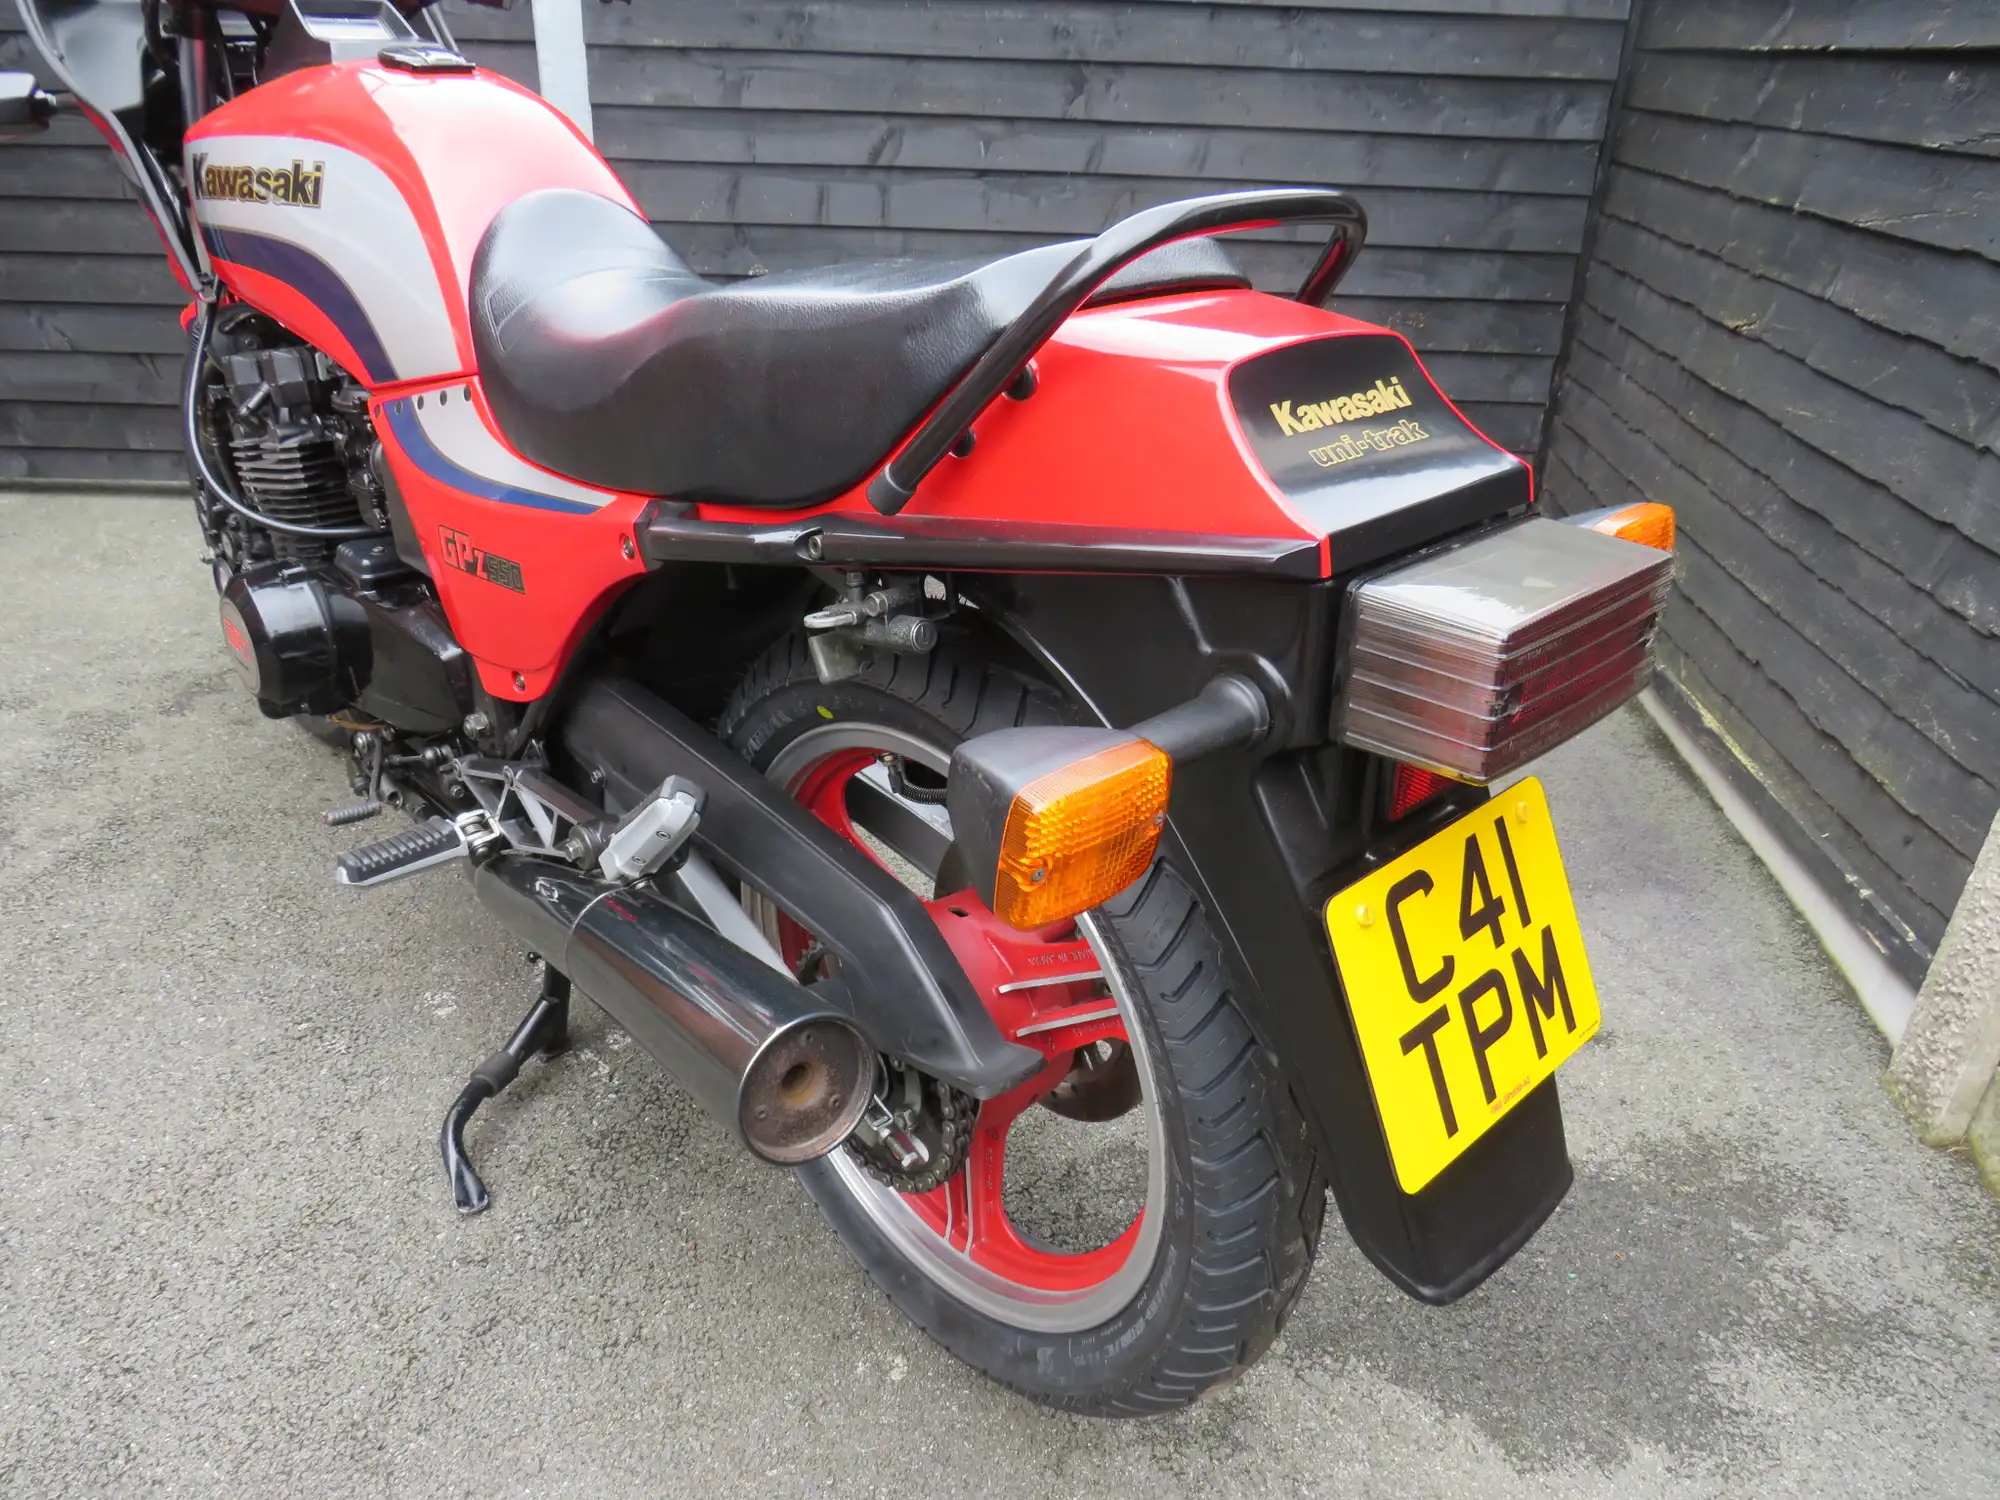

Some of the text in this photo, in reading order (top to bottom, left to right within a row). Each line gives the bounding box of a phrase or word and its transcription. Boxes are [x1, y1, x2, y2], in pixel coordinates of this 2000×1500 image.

[192, 152, 325, 209] Kawasaki
[1270, 376, 1412, 436] Kawasaki
[1308, 419, 1429, 467] uni-trak
[1386, 815, 1532, 1003] C41
[1399, 924, 1577, 1140] TPM
